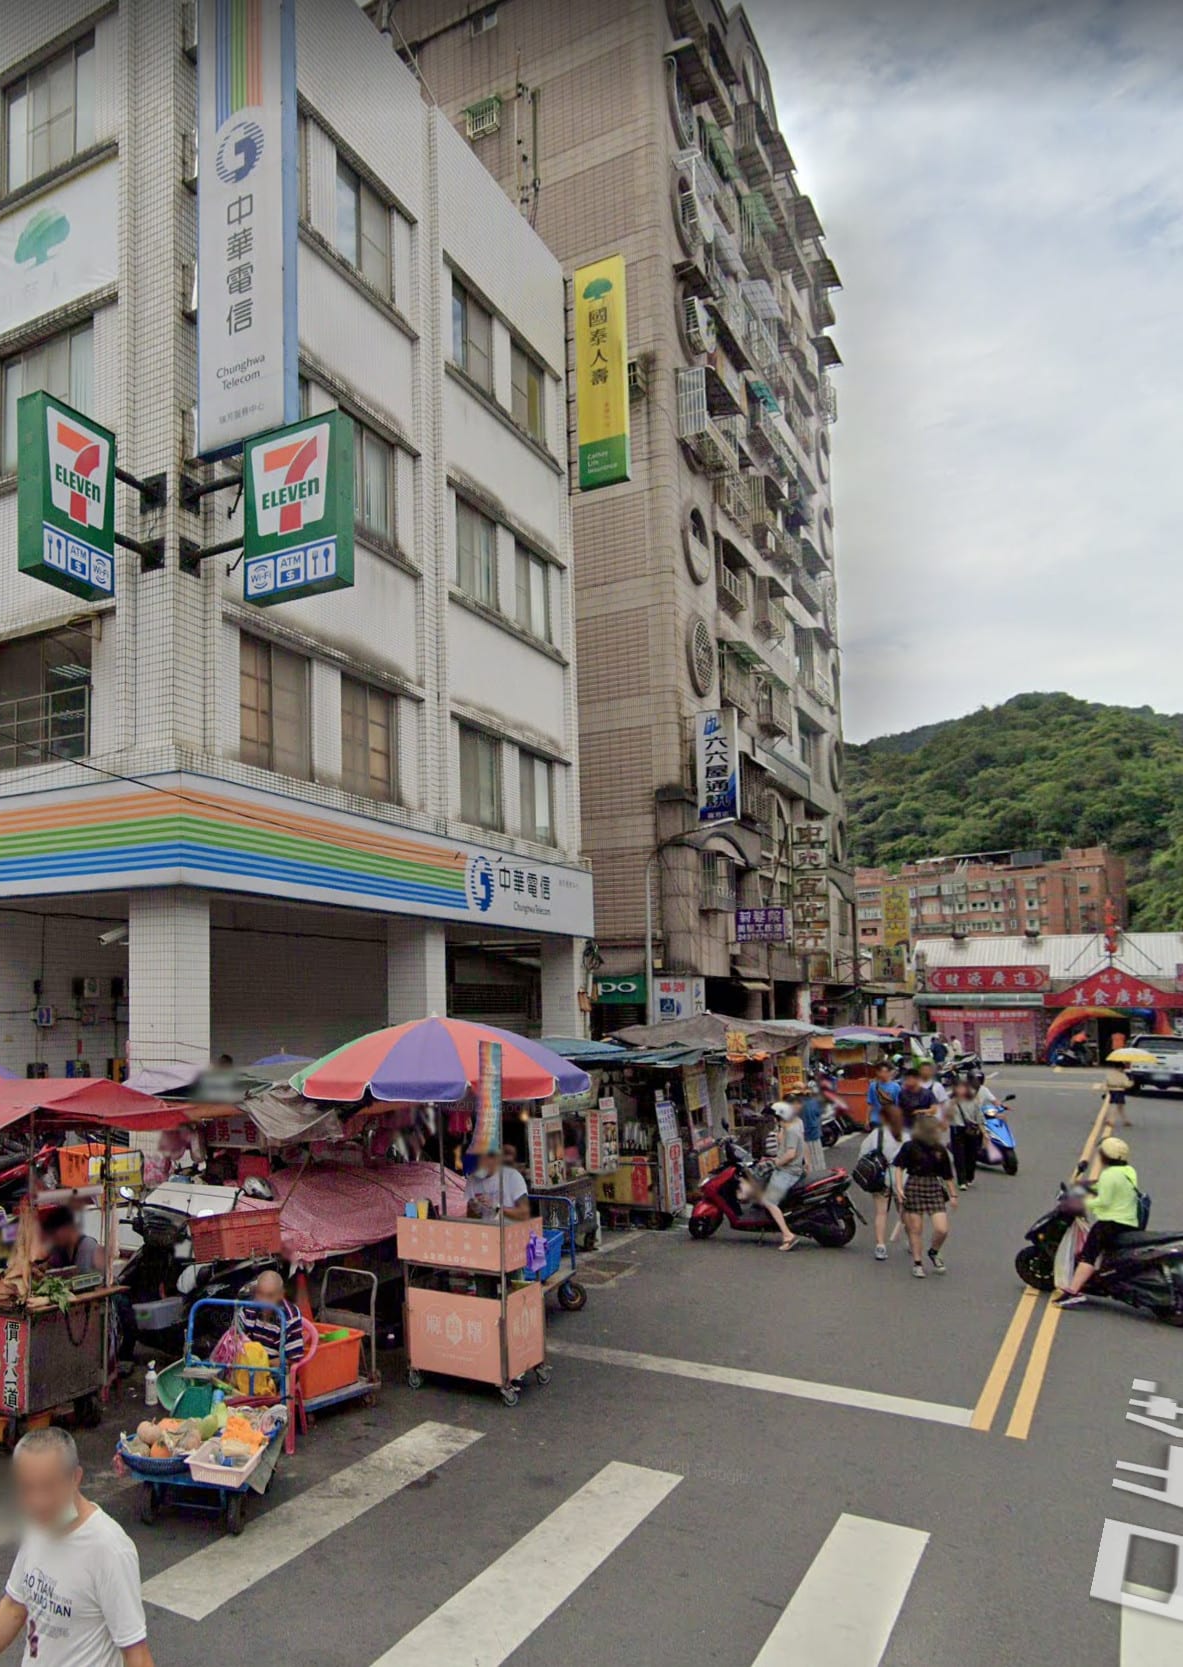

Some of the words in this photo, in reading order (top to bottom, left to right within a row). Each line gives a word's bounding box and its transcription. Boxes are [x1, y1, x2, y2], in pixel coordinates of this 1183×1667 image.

[226, 194, 254, 336] 中華電信
[589, 307, 608, 386] 國泰人壽
[216, 354, 265, 380] Chunghwa
[222, 369, 261, 391] Telecom
[55, 463, 102, 504] ELEVEN
[262, 477, 320, 511] ELEVEN
[70, 544, 87, 560] ATM
[280, 555, 302, 569] ATM
[704, 736, 729, 808] 六六屋通訊
[1072, 988, 1155, 1005] 美食廣場
[49, 1600, 72, 1618] TIAN
